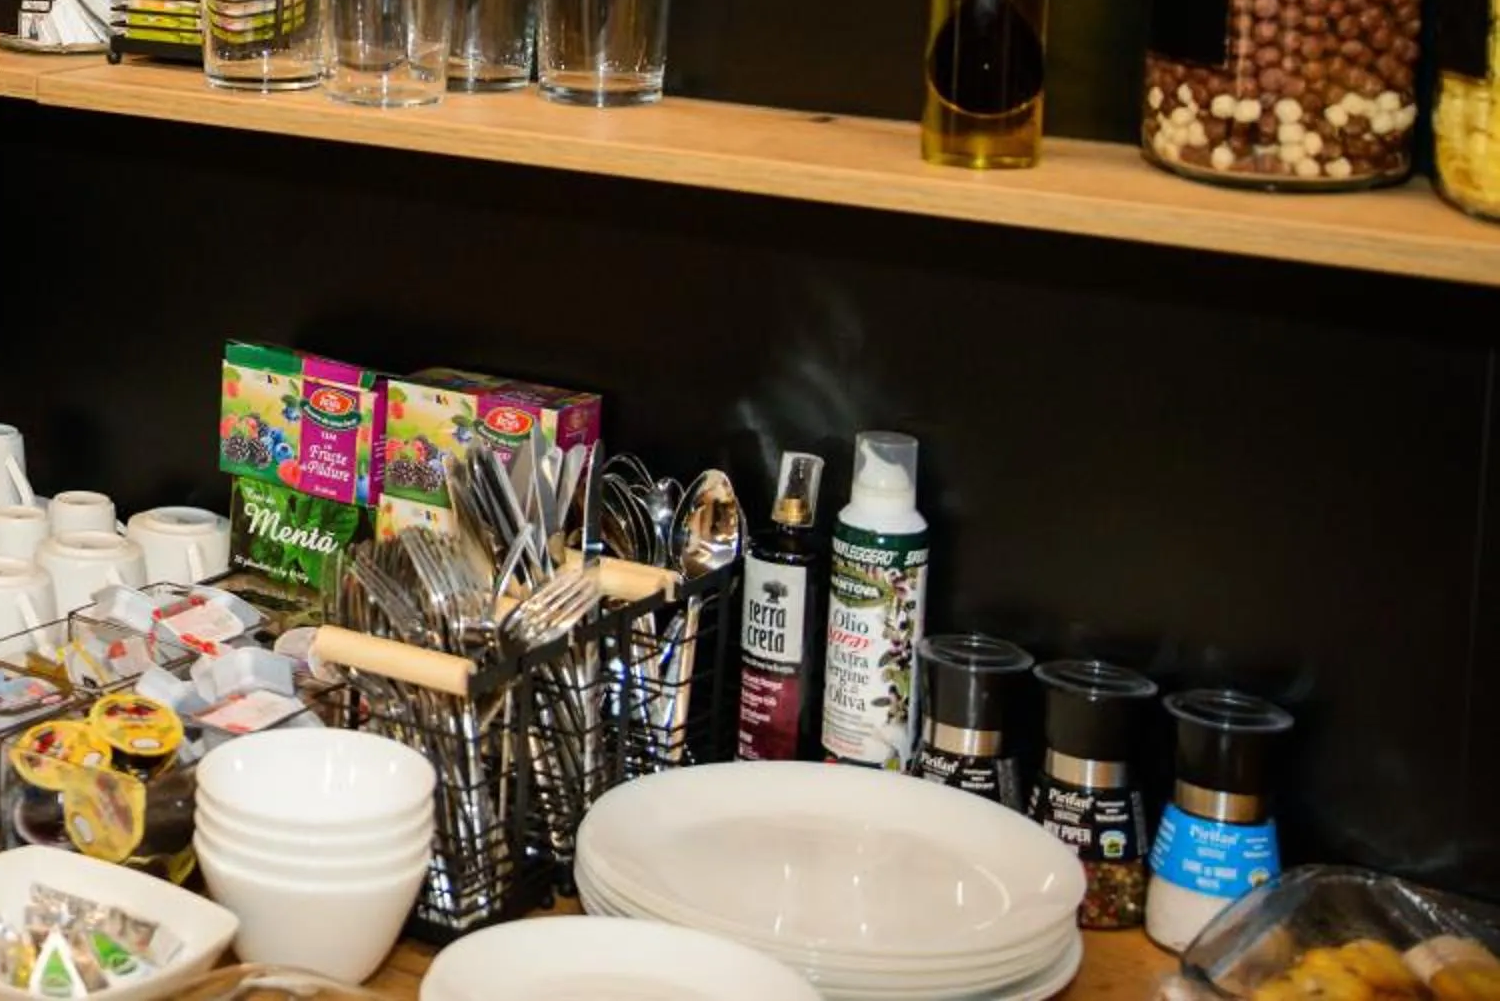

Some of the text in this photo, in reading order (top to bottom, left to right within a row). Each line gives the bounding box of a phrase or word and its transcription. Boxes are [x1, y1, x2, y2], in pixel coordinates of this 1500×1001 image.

[243, 502, 339, 554] Mentă
[748, 599, 787, 629] terra
[833, 608, 869, 635] Olio
[747, 624, 785, 654] creta
